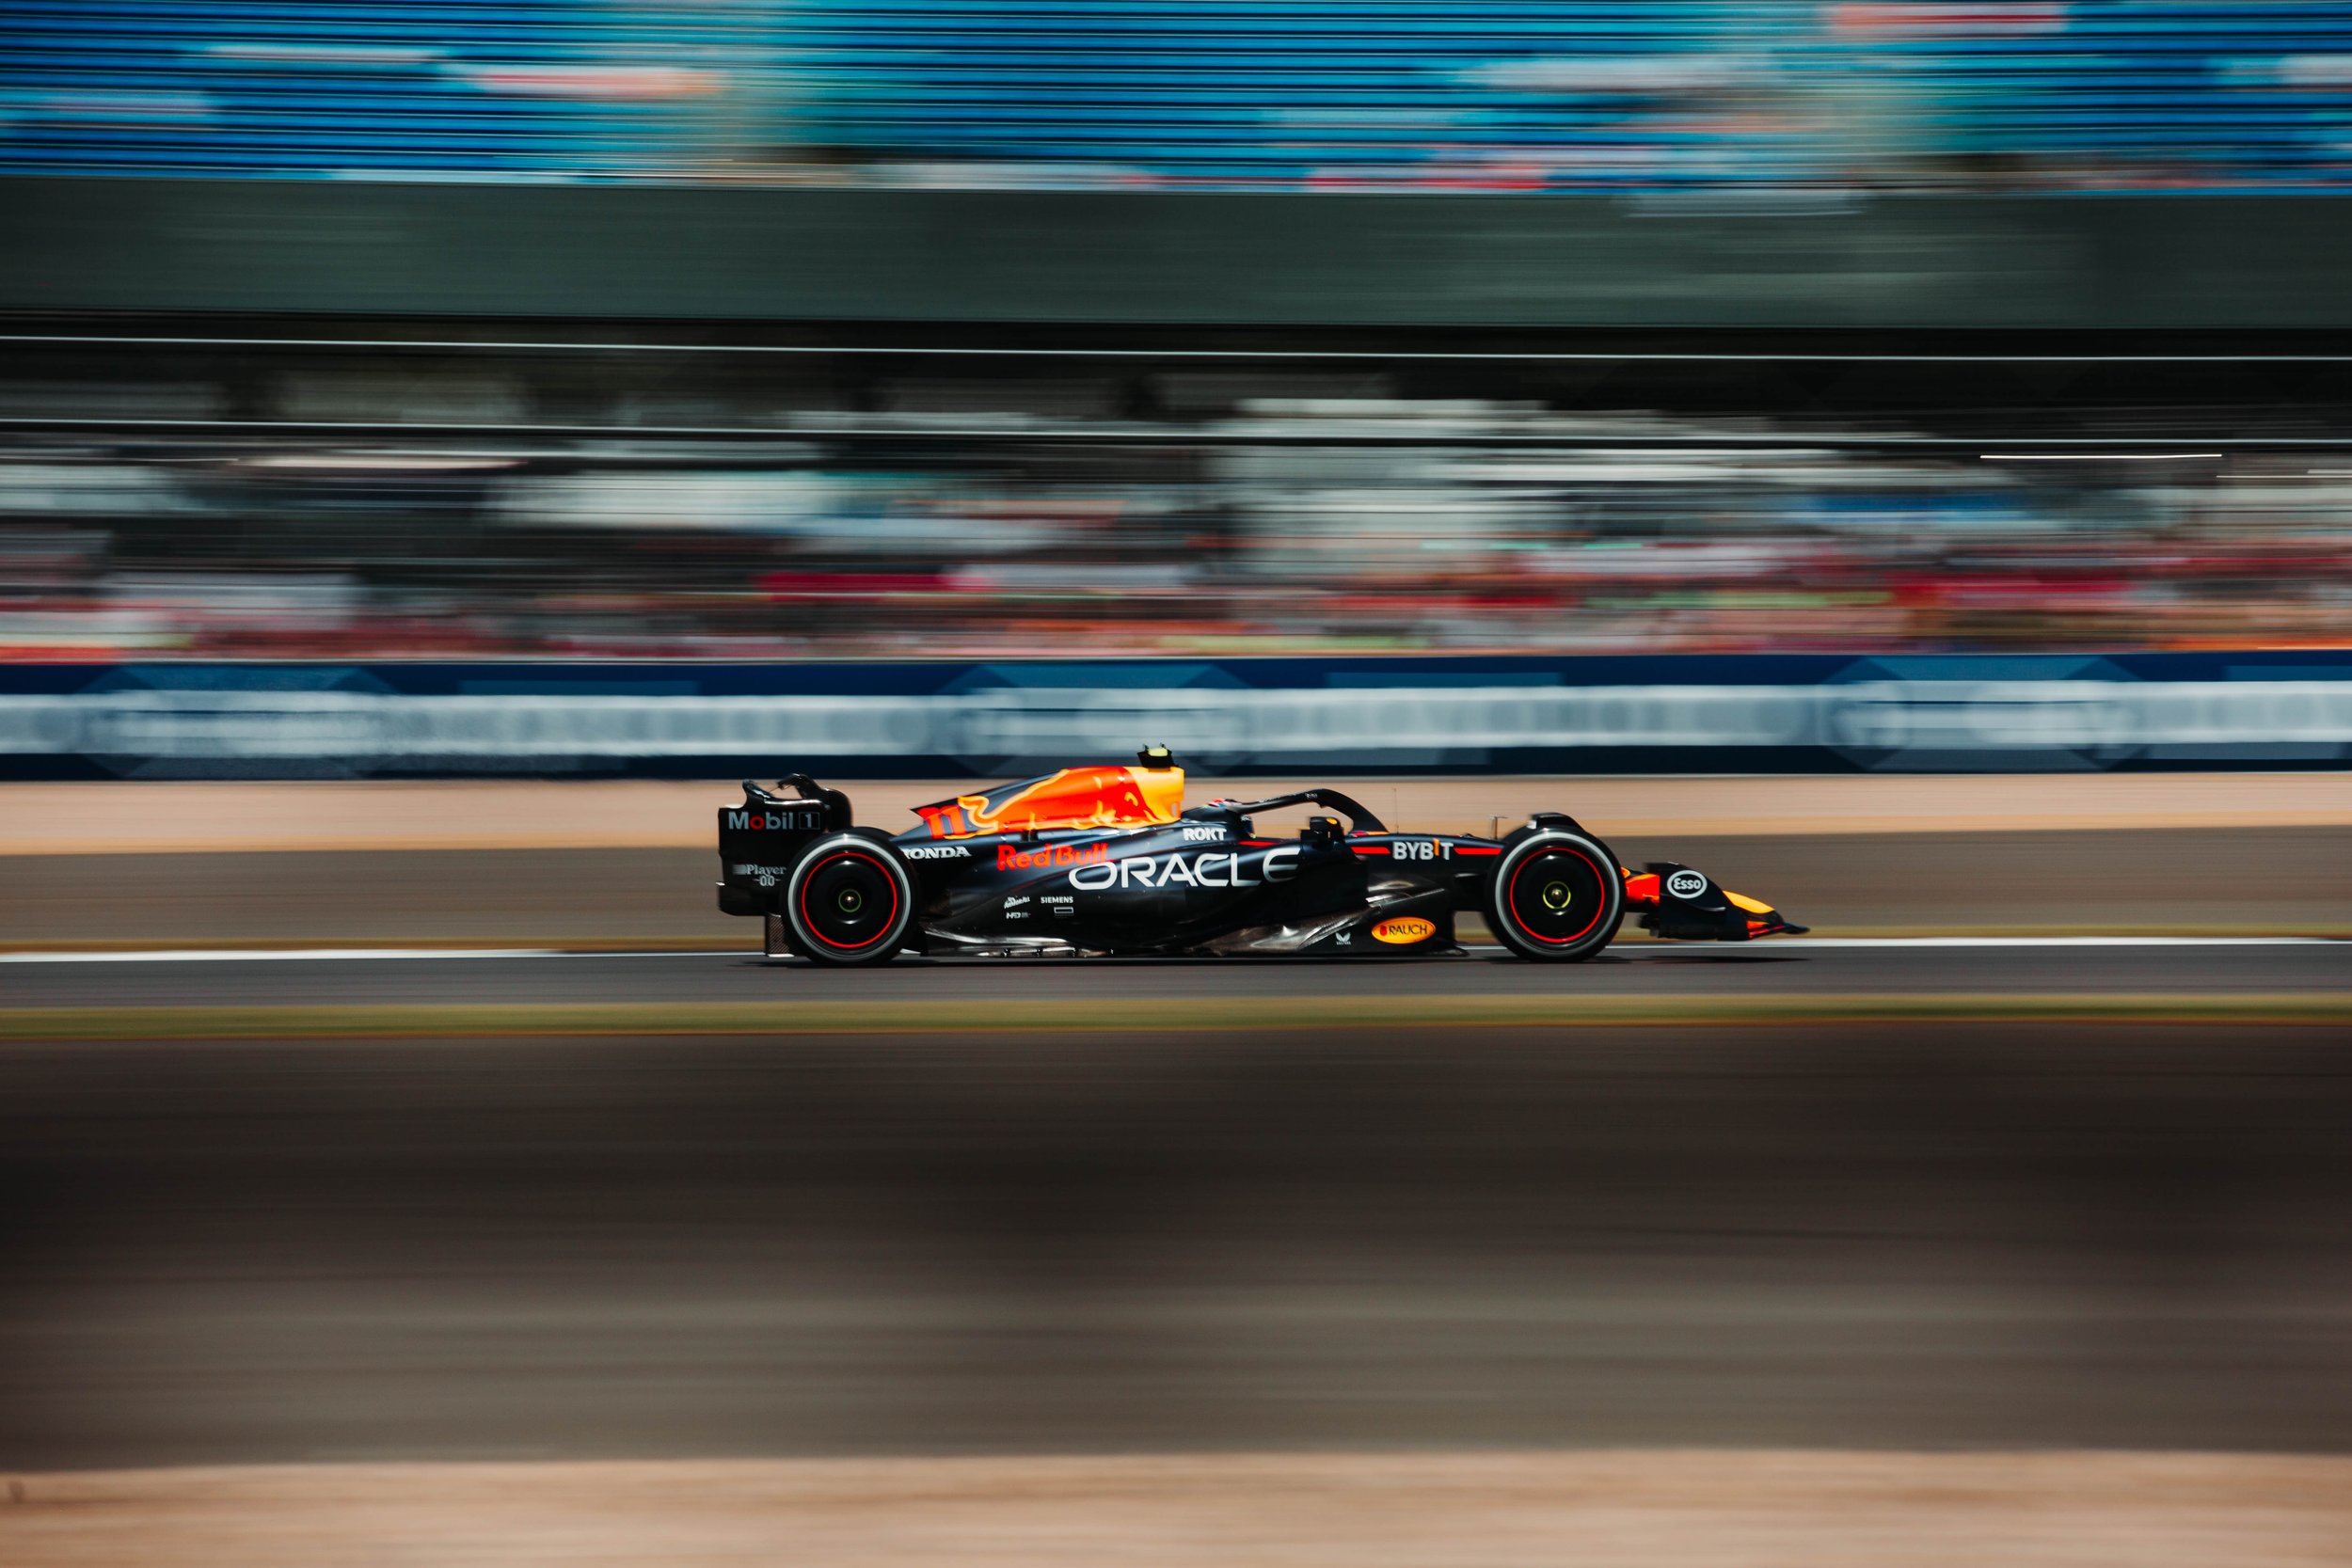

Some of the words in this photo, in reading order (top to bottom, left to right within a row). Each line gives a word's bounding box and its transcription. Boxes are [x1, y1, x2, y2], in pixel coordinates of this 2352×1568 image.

[728, 812, 794, 831] Mobil
[1183, 828, 1227, 841] ROKT
[1392, 838, 1454, 861] BYBIT
[997, 843, 1053, 871] Red
[1055, 843, 1108, 865] Bull
[746, 863, 787, 877] Player
[1069, 847, 1301, 890] ORACLE
[1673, 878, 1701, 891] Esso
[1041, 895, 1073, 904] SIEMENS
[1389, 924, 1427, 935] RAUCH
